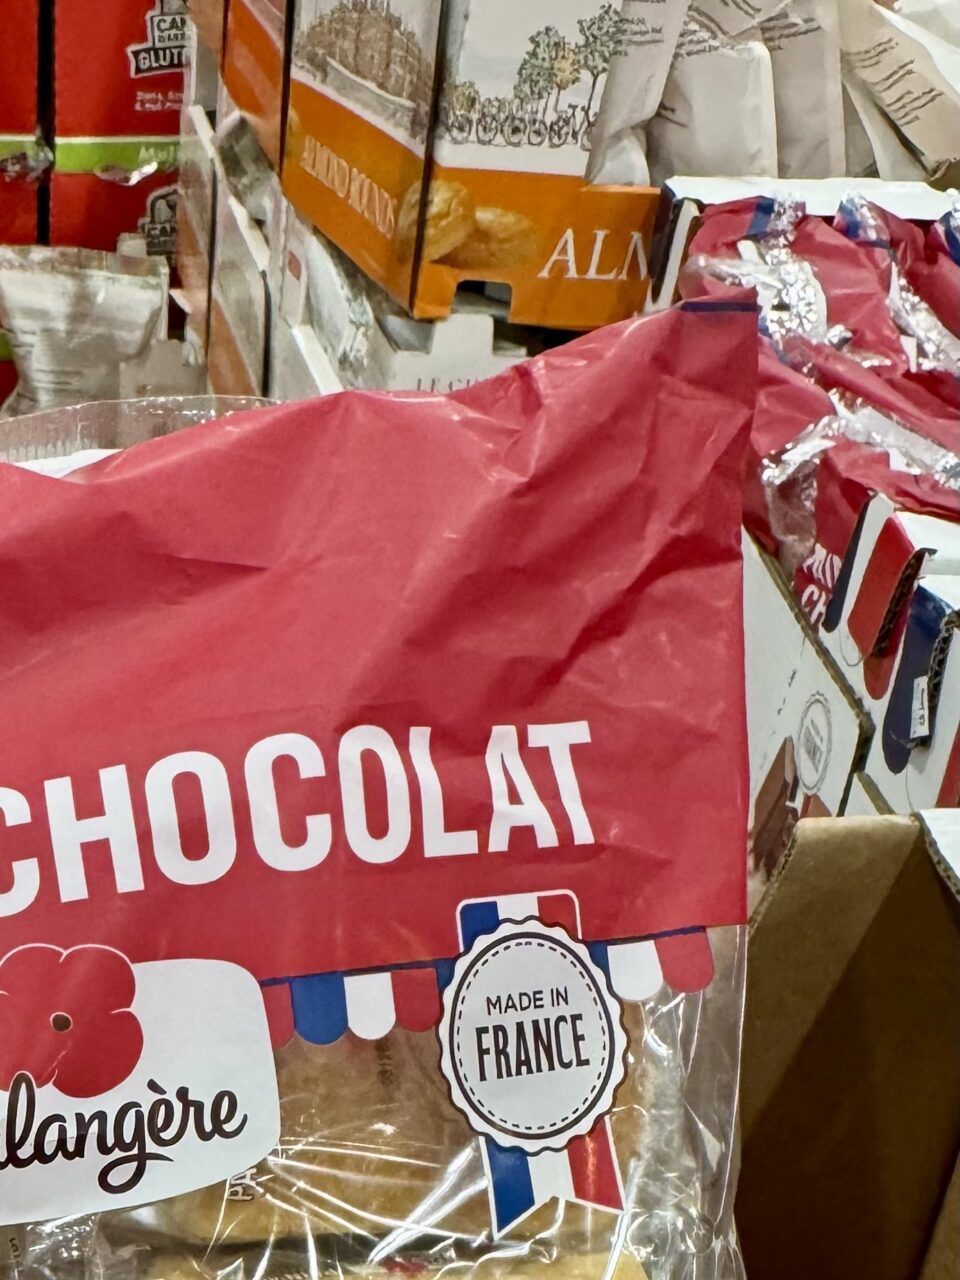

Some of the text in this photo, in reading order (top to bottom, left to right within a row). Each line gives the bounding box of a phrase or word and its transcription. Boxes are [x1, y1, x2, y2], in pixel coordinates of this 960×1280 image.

[137, 49, 187, 70] GLUT
[486, 986, 570, 1016] MADE IN
[475, 1013, 591, 1082] FRANCE
